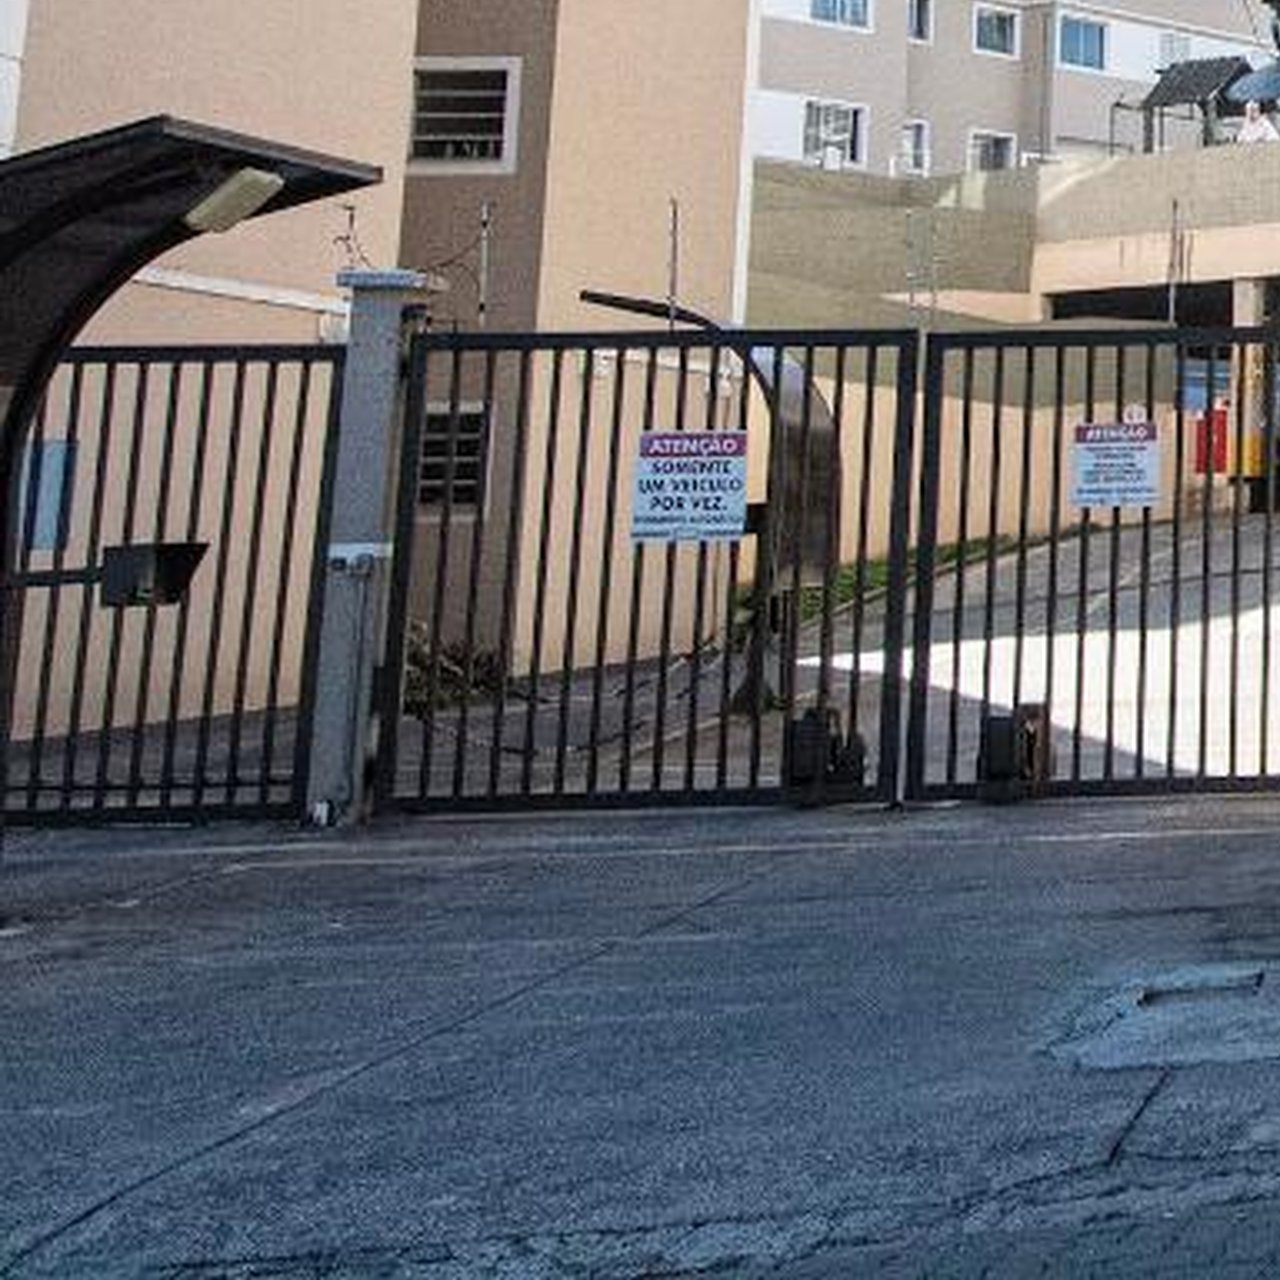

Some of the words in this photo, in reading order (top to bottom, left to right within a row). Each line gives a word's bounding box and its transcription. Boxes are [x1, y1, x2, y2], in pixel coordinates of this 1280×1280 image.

[648, 437, 739, 456] ATENÇÃO
[651, 459, 732, 475] SOMENTE
[638, 478, 665, 494] UM
[649, 496, 685, 511] POR
